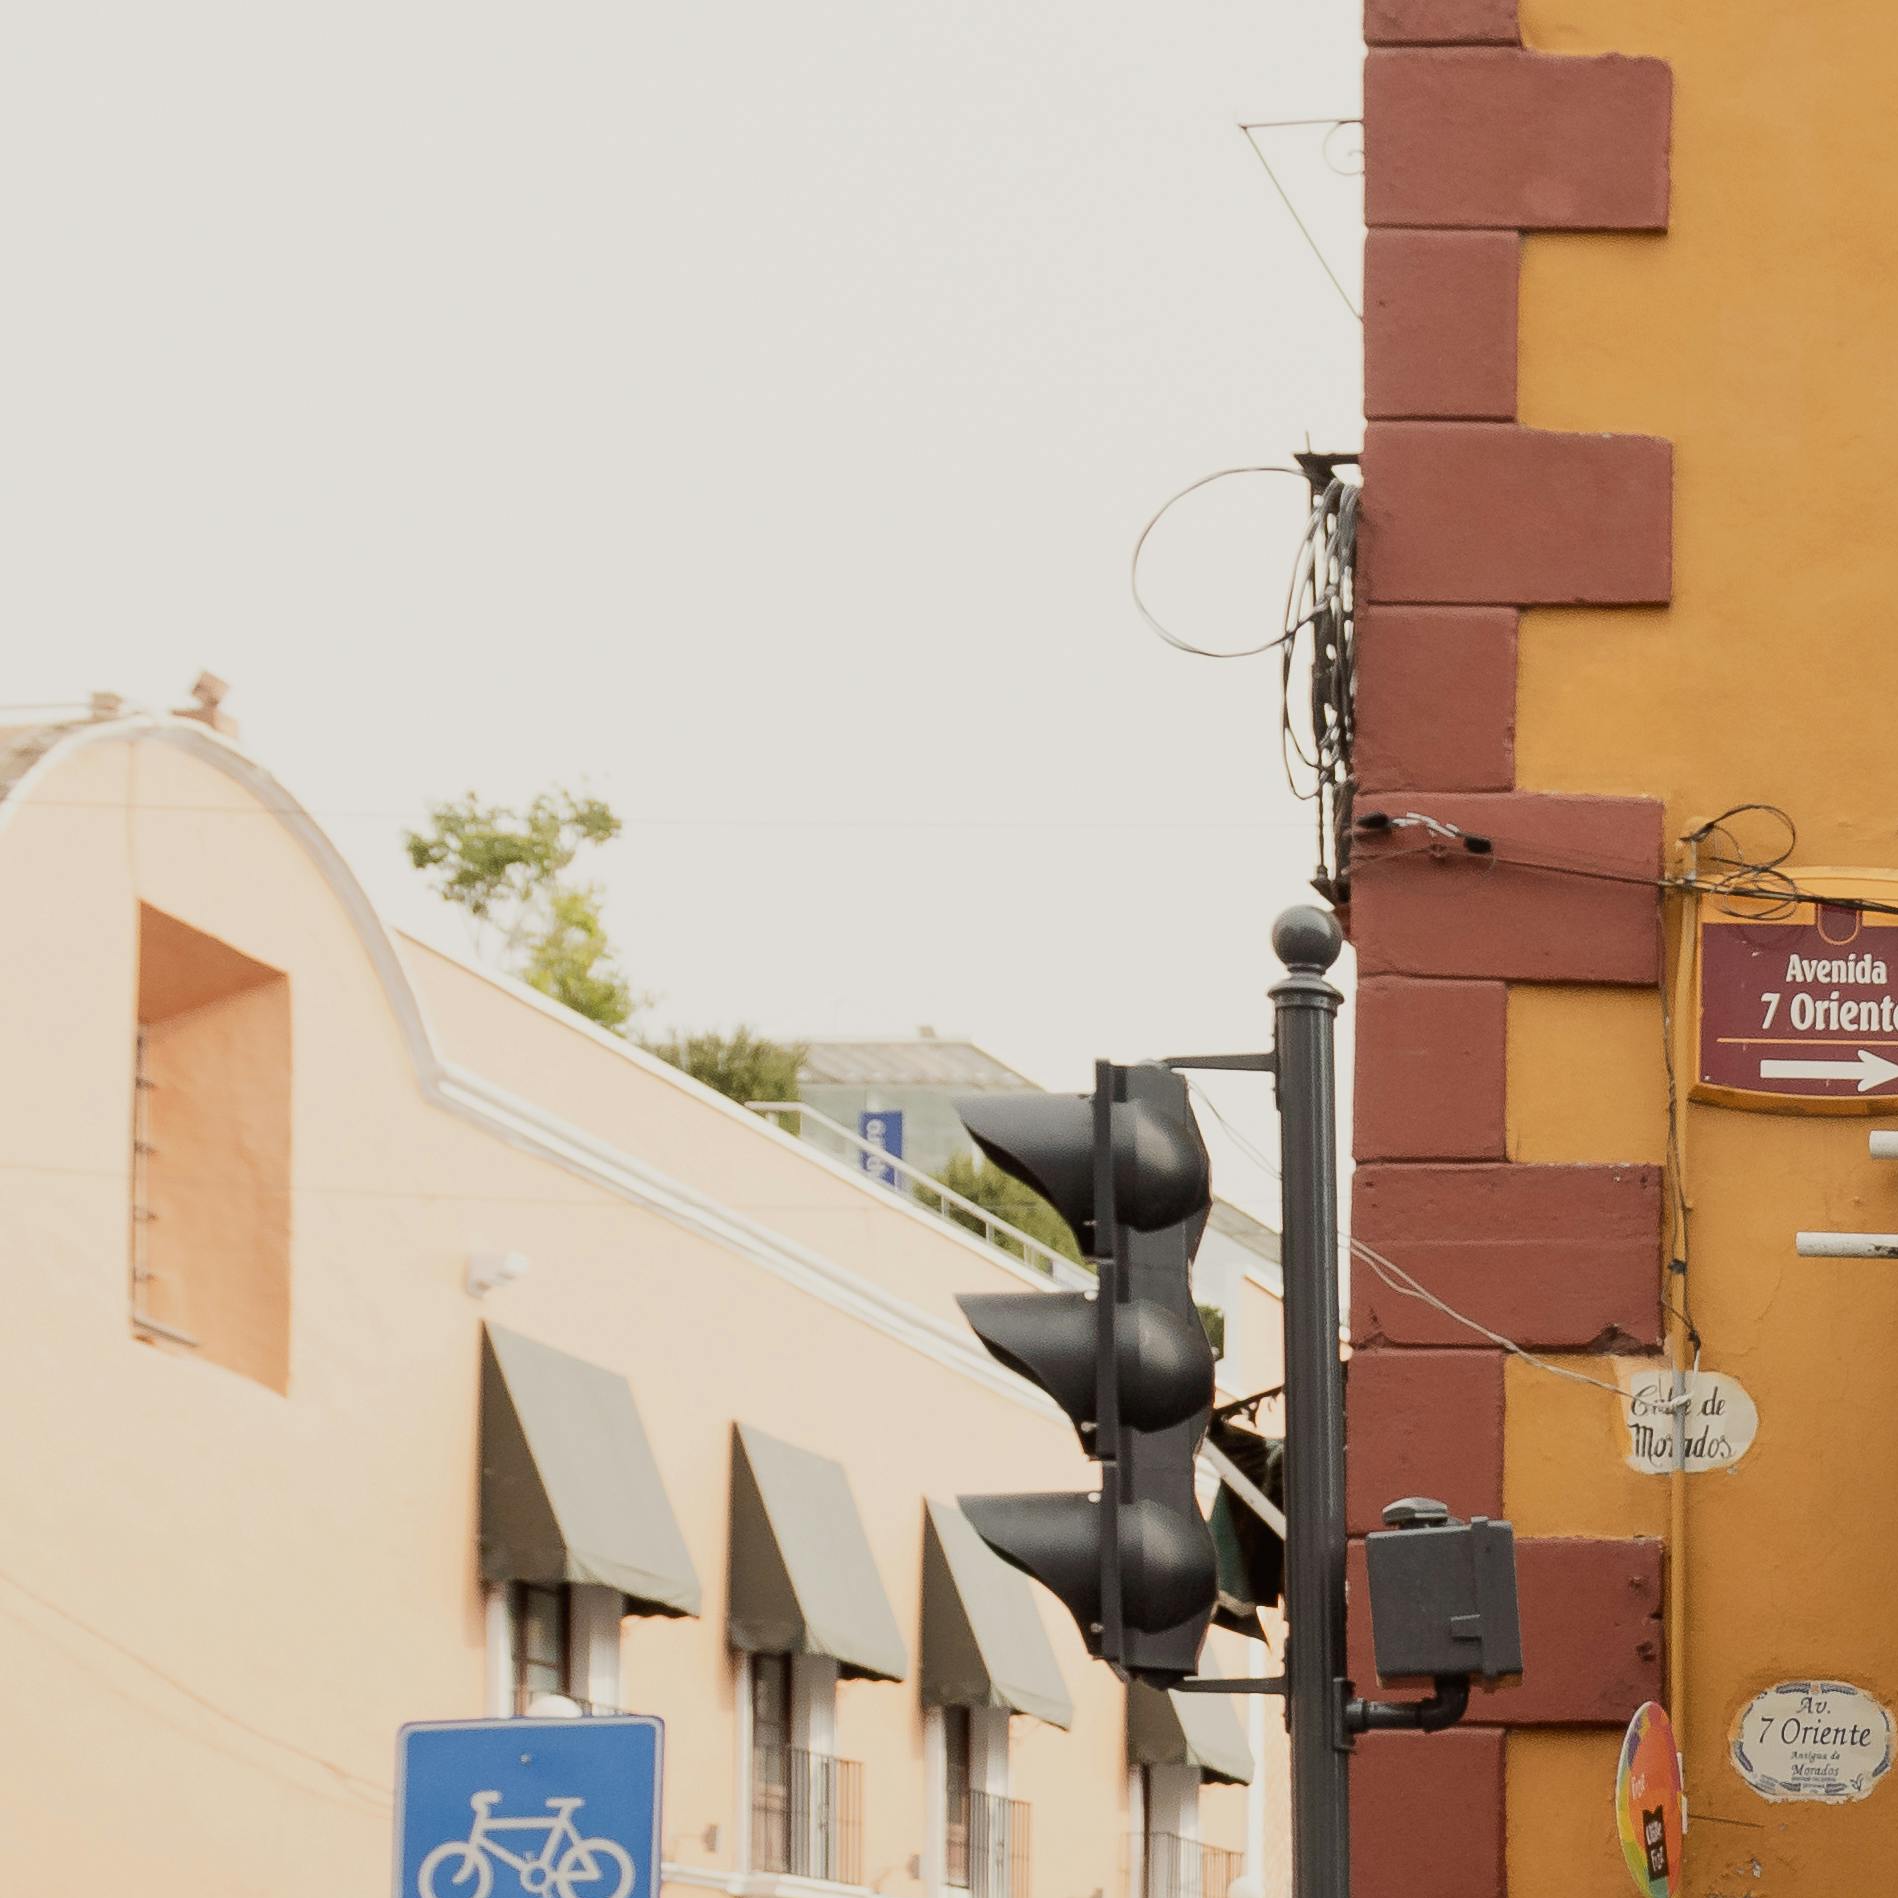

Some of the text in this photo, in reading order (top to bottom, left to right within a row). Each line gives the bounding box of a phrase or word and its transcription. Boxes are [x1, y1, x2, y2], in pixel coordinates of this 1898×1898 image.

[1786, 953, 1887, 985] Avenida
[1760, 993, 1781, 1030] 7
[1697, 1386, 1726, 1416] de
[1796, 1696, 1832, 1714] Av.
[1759, 1717, 1871, 1747] 7 Oriente
[1791, 1763, 1840, 1777] Morados
